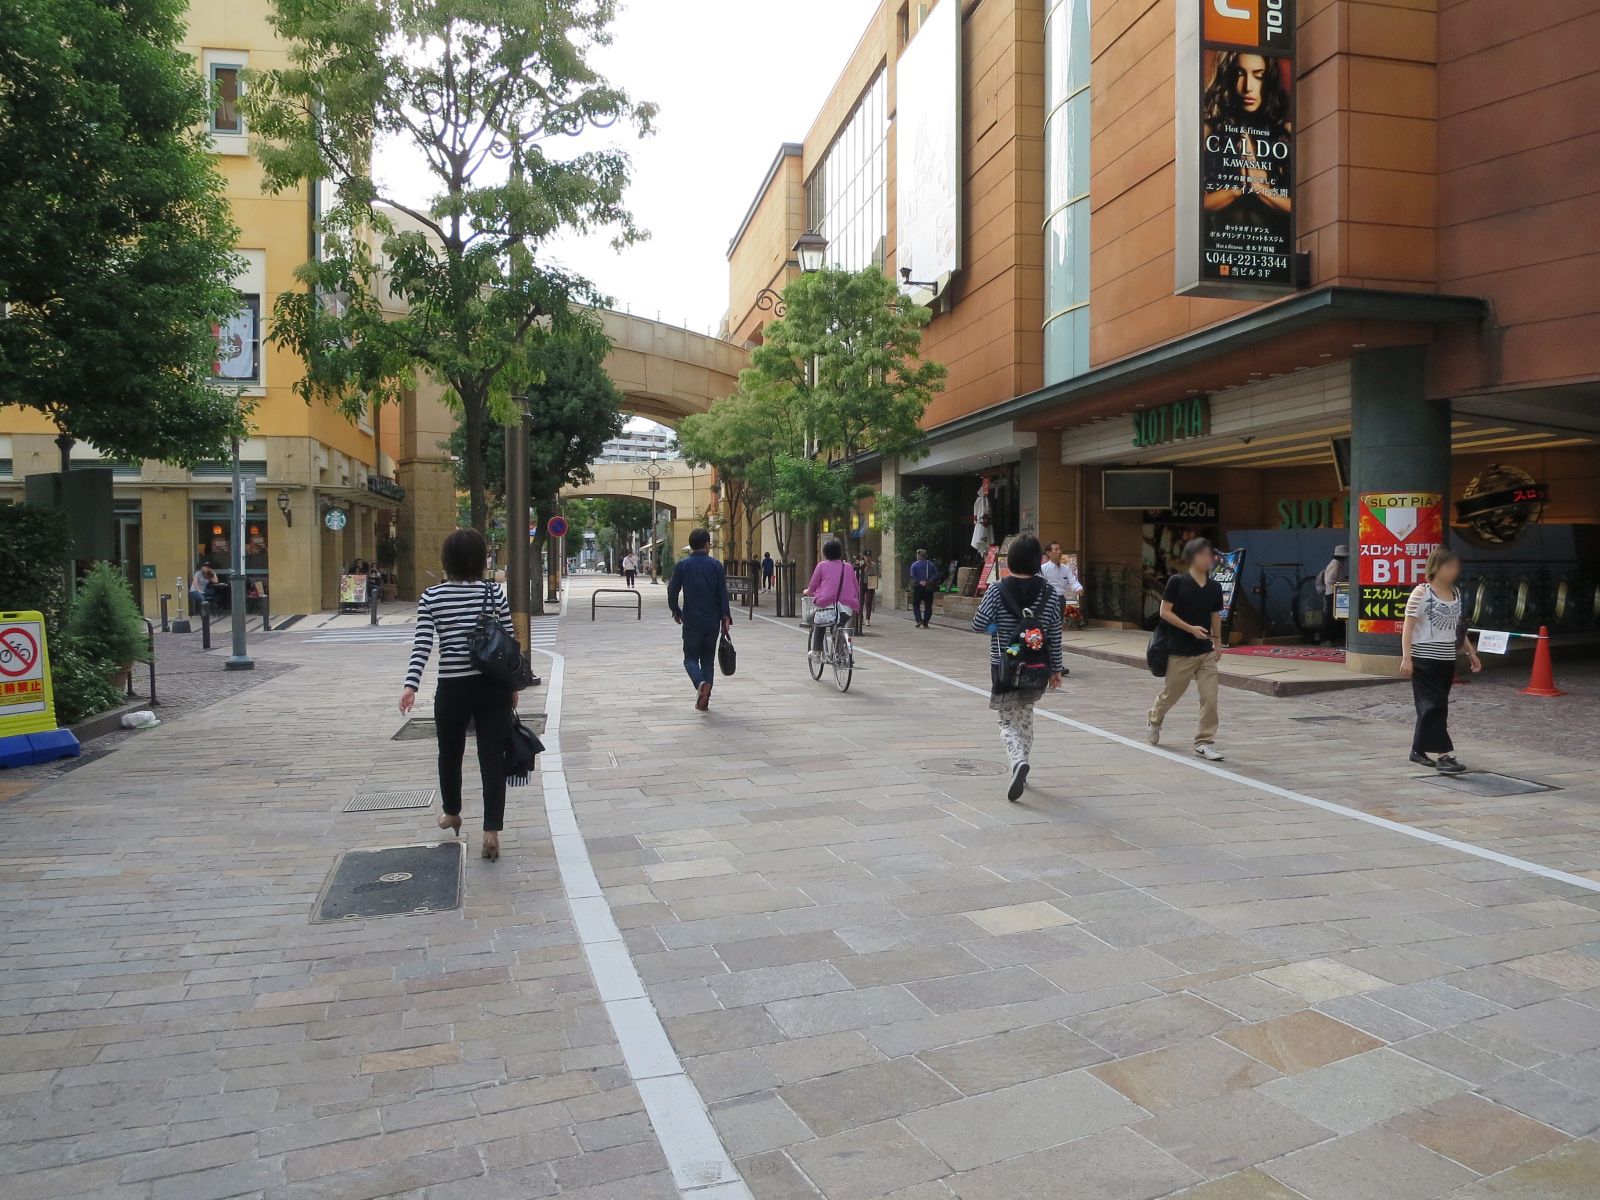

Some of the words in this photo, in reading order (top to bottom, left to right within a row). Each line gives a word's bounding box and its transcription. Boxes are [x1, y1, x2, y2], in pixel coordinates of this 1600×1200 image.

[1225, 124, 1238, 134] Hot
[1239, 126, 1247, 134] &
[1206, 135, 1288, 159] CALDO
[1223, 158, 1272, 170] KAWASAKI
[1213, 252, 1287, 268] 044-221-3344
[1132, 405, 1168, 448] SLOT
[1173, 399, 1202, 440] PIA
[1370, 497, 1408, 508] SLOT
[1411, 497, 1433, 507] PIA
[1278, 497, 1333, 529] SLOT
[1372, 559, 1427, 583] B1F
[1363, 588, 1411, 599] エスカレー
